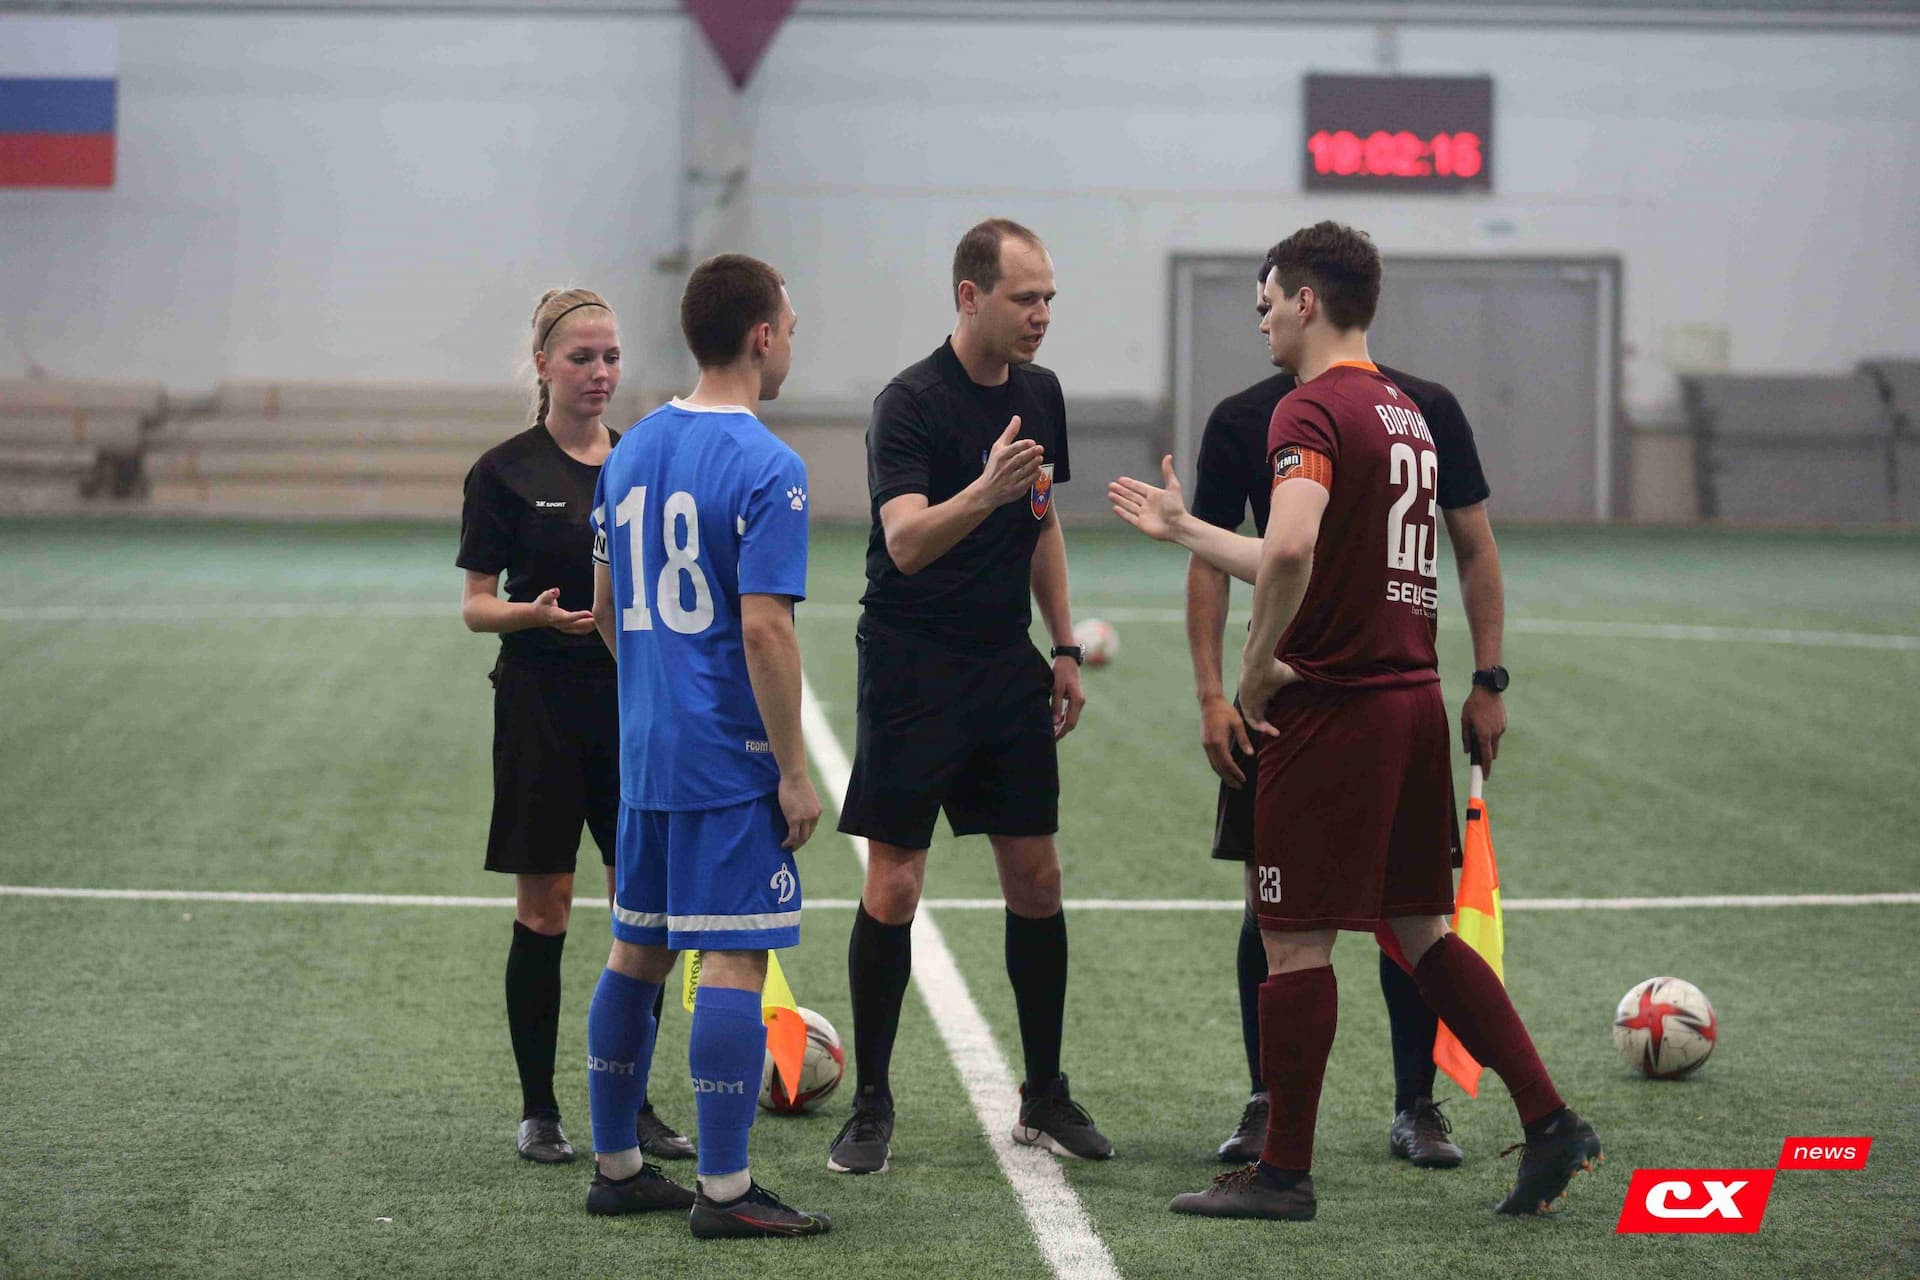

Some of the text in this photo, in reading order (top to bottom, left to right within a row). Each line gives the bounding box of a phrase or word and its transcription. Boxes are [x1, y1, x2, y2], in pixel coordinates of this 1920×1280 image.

[616, 486, 714, 634] 18
[1387, 443, 1437, 578] 23
[1258, 865, 1282, 903] 23
